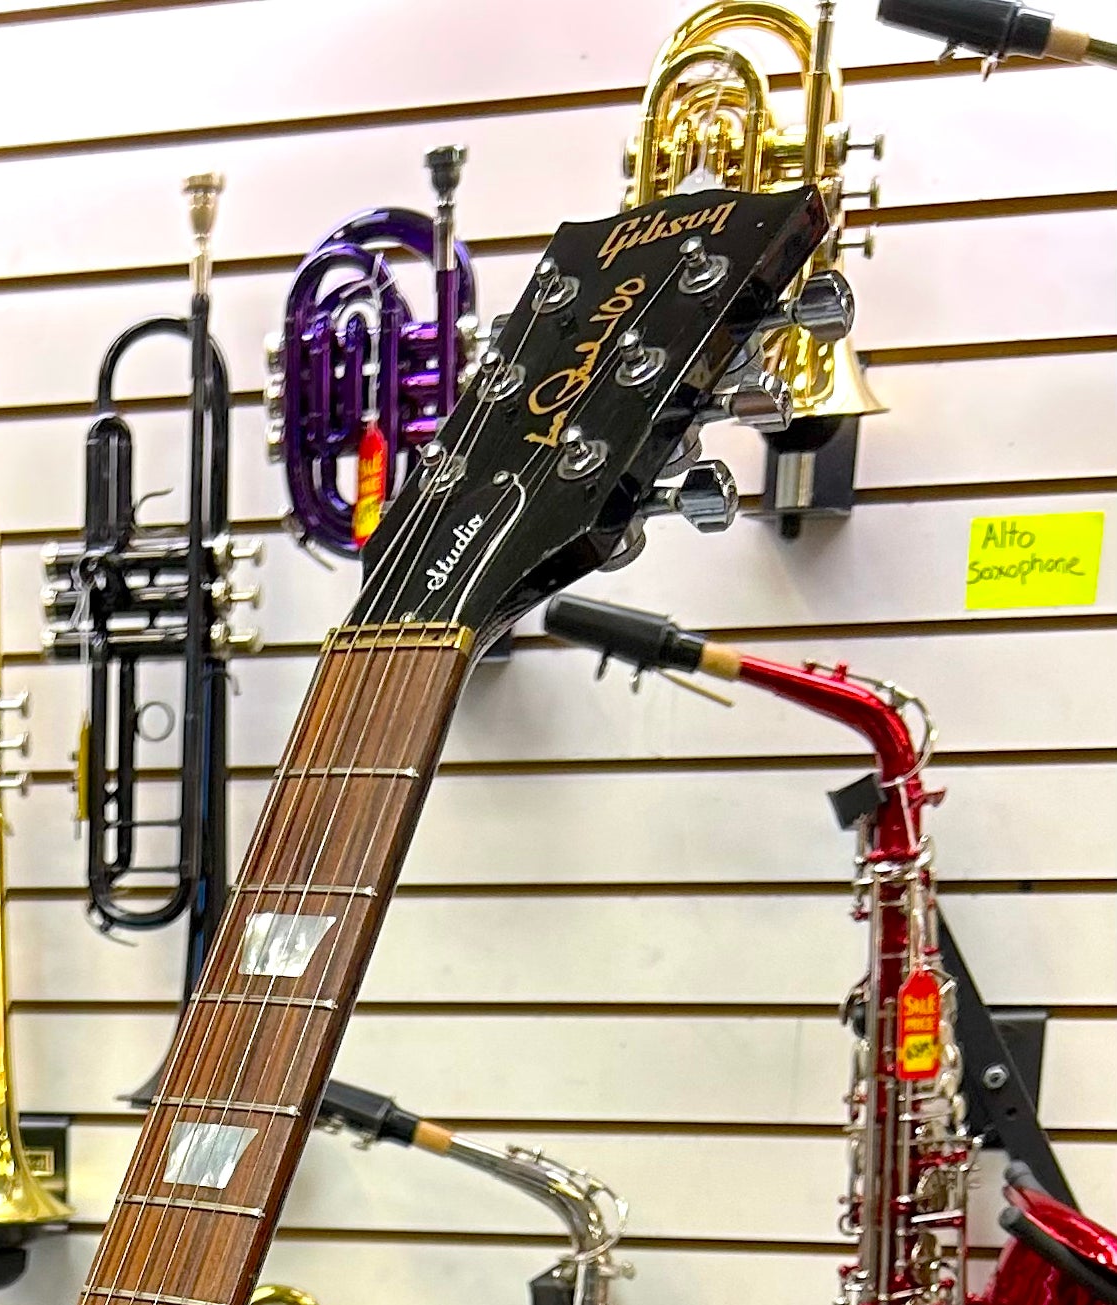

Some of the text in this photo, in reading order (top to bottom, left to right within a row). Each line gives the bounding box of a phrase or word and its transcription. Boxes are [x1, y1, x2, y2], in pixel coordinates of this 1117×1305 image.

[596, 200, 738, 270] Gibson
[528, 341, 602, 415] Paul
[523, 410, 570, 448] Les
[426, 514, 483, 592] Studio
[981, 520, 1036, 549] Alto
